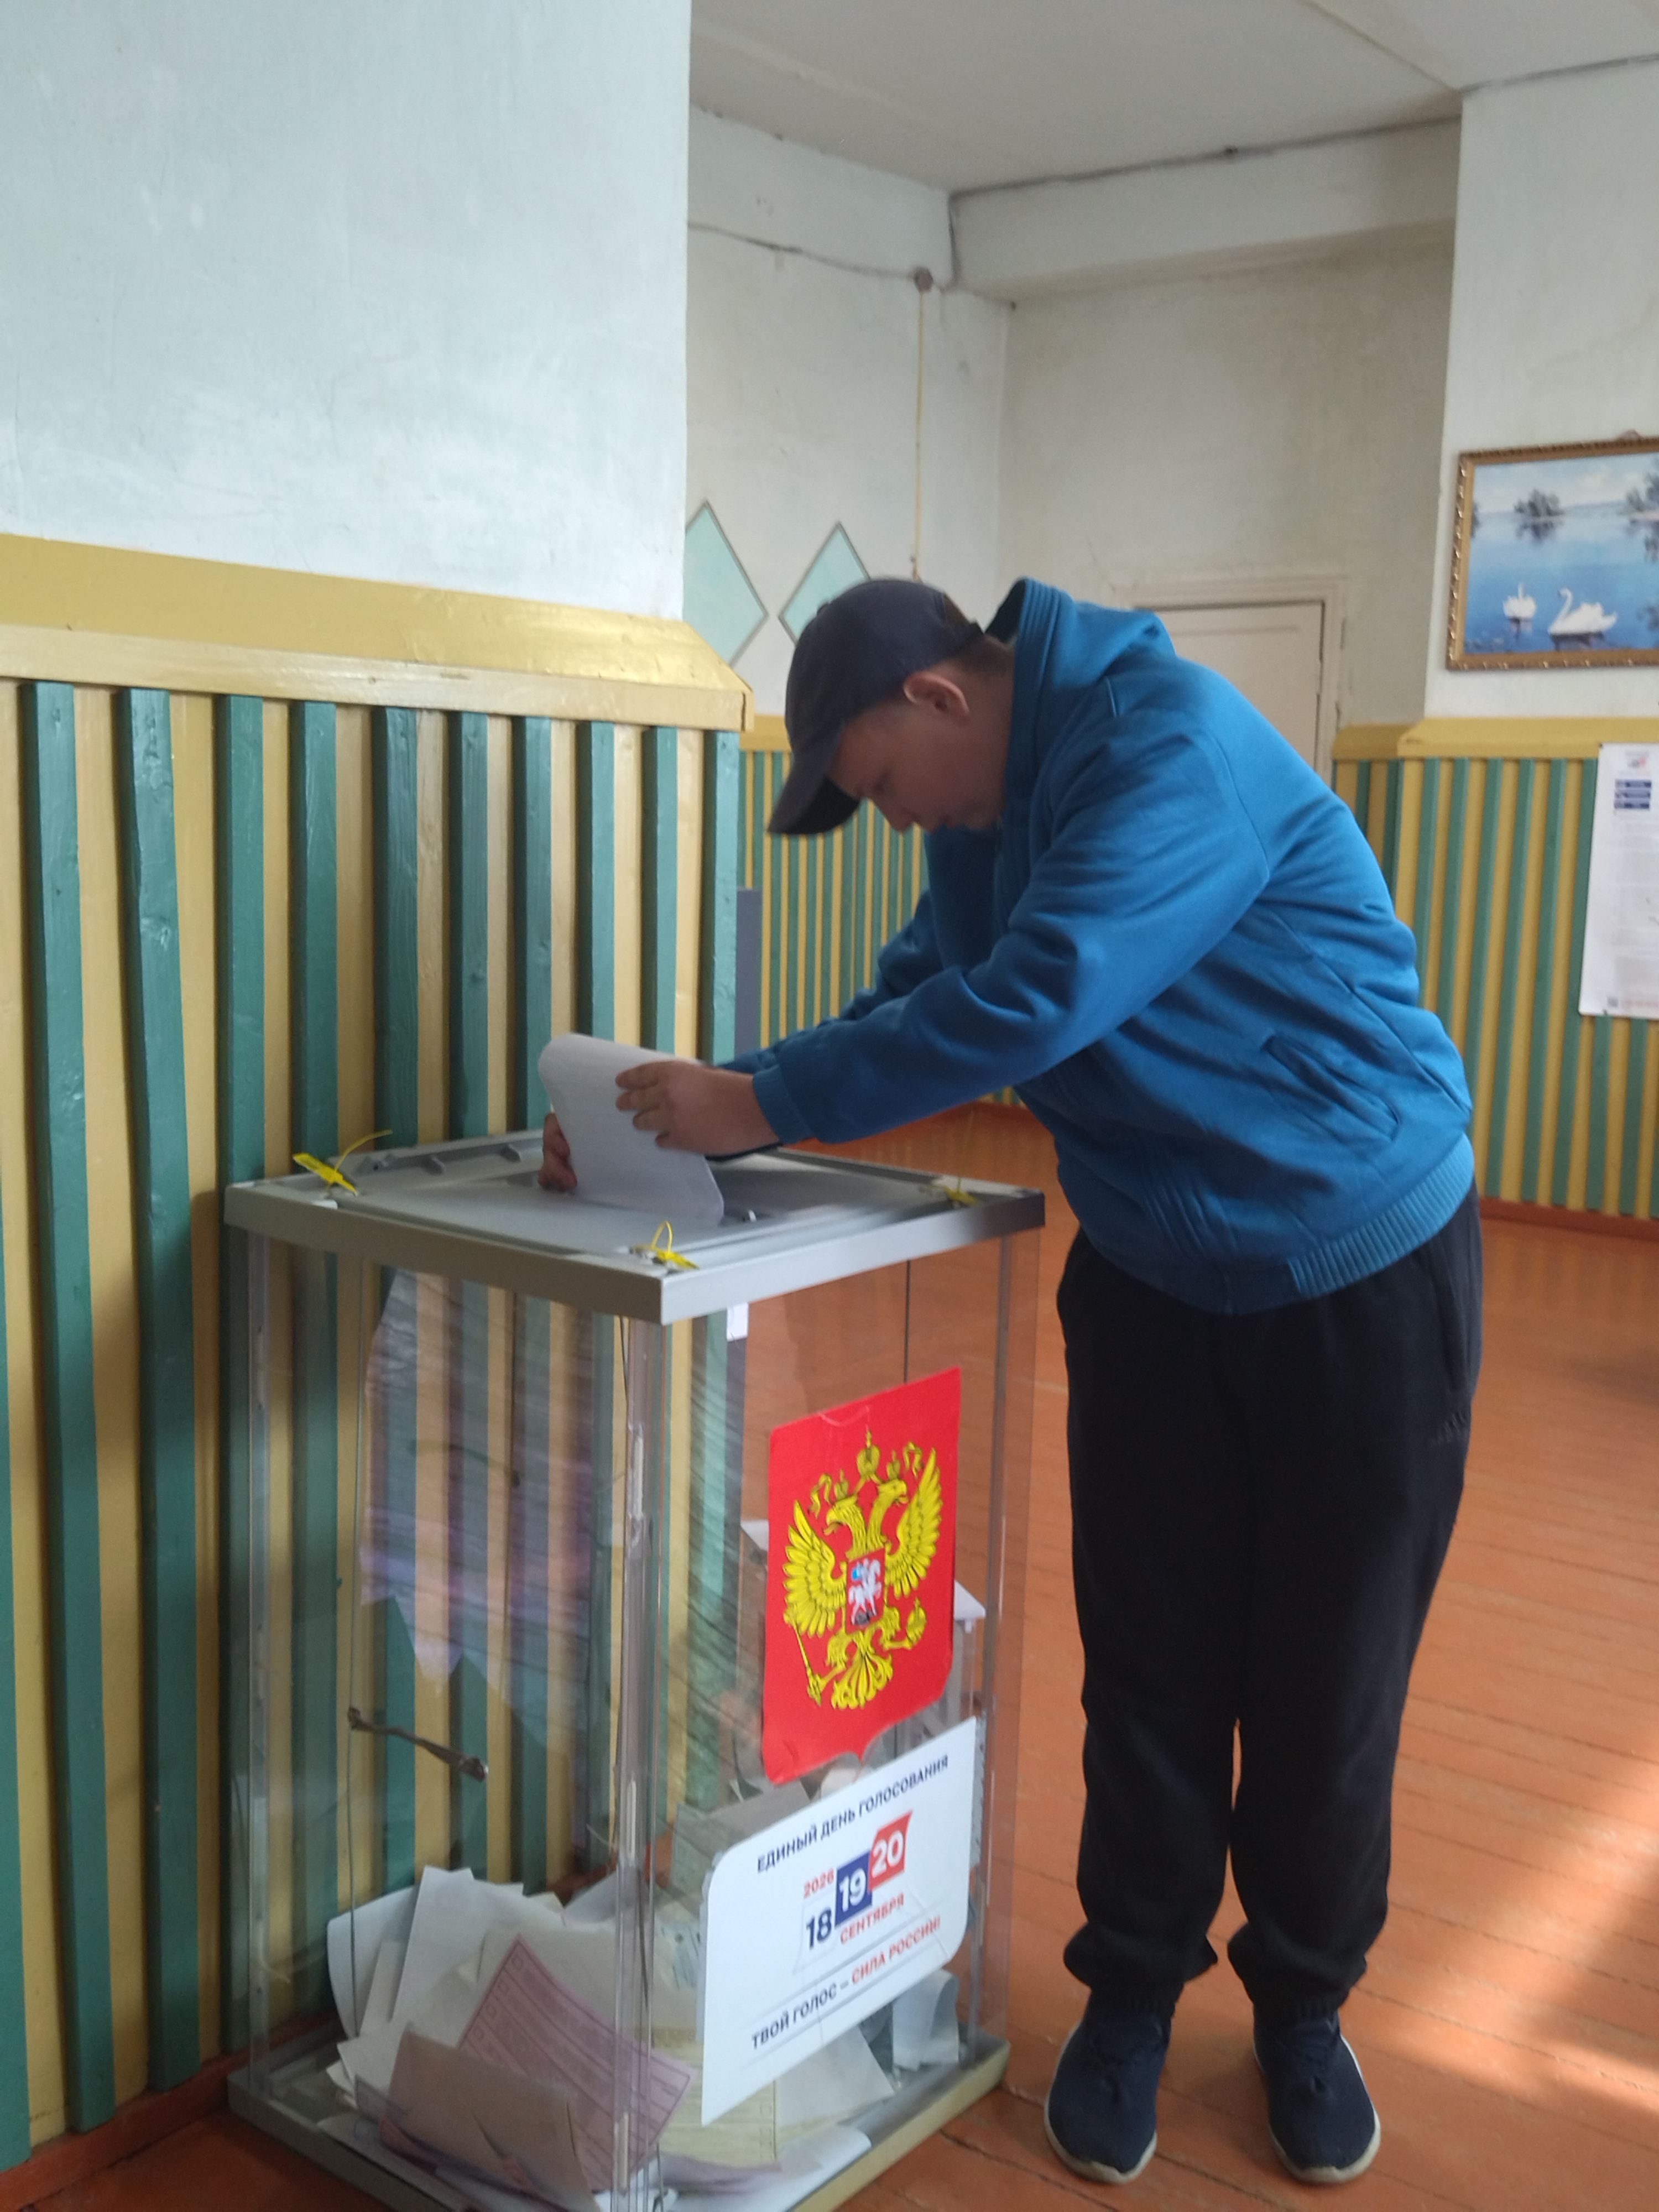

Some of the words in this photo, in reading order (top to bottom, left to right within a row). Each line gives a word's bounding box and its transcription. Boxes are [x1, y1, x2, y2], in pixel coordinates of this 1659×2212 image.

[757, 1824, 817, 1874] ЕДИНЫЙ
[821, 1808, 855, 1840] ДЕНЬ
[859, 1754, 949, 1817] ГОЛОСОВАНИЯ
[806, 1908, 832, 1948] 18
[839, 1867, 867, 1912] 19
[872, 1830, 904, 1878] 20
[841, 1892, 904, 1944] СЕНТЯБРЯ
[752, 2011, 789, 2049] ТВОЙ
[793, 1984, 837, 2023] ГОЛОС
[852, 1952, 886, 1984] СИЛА
